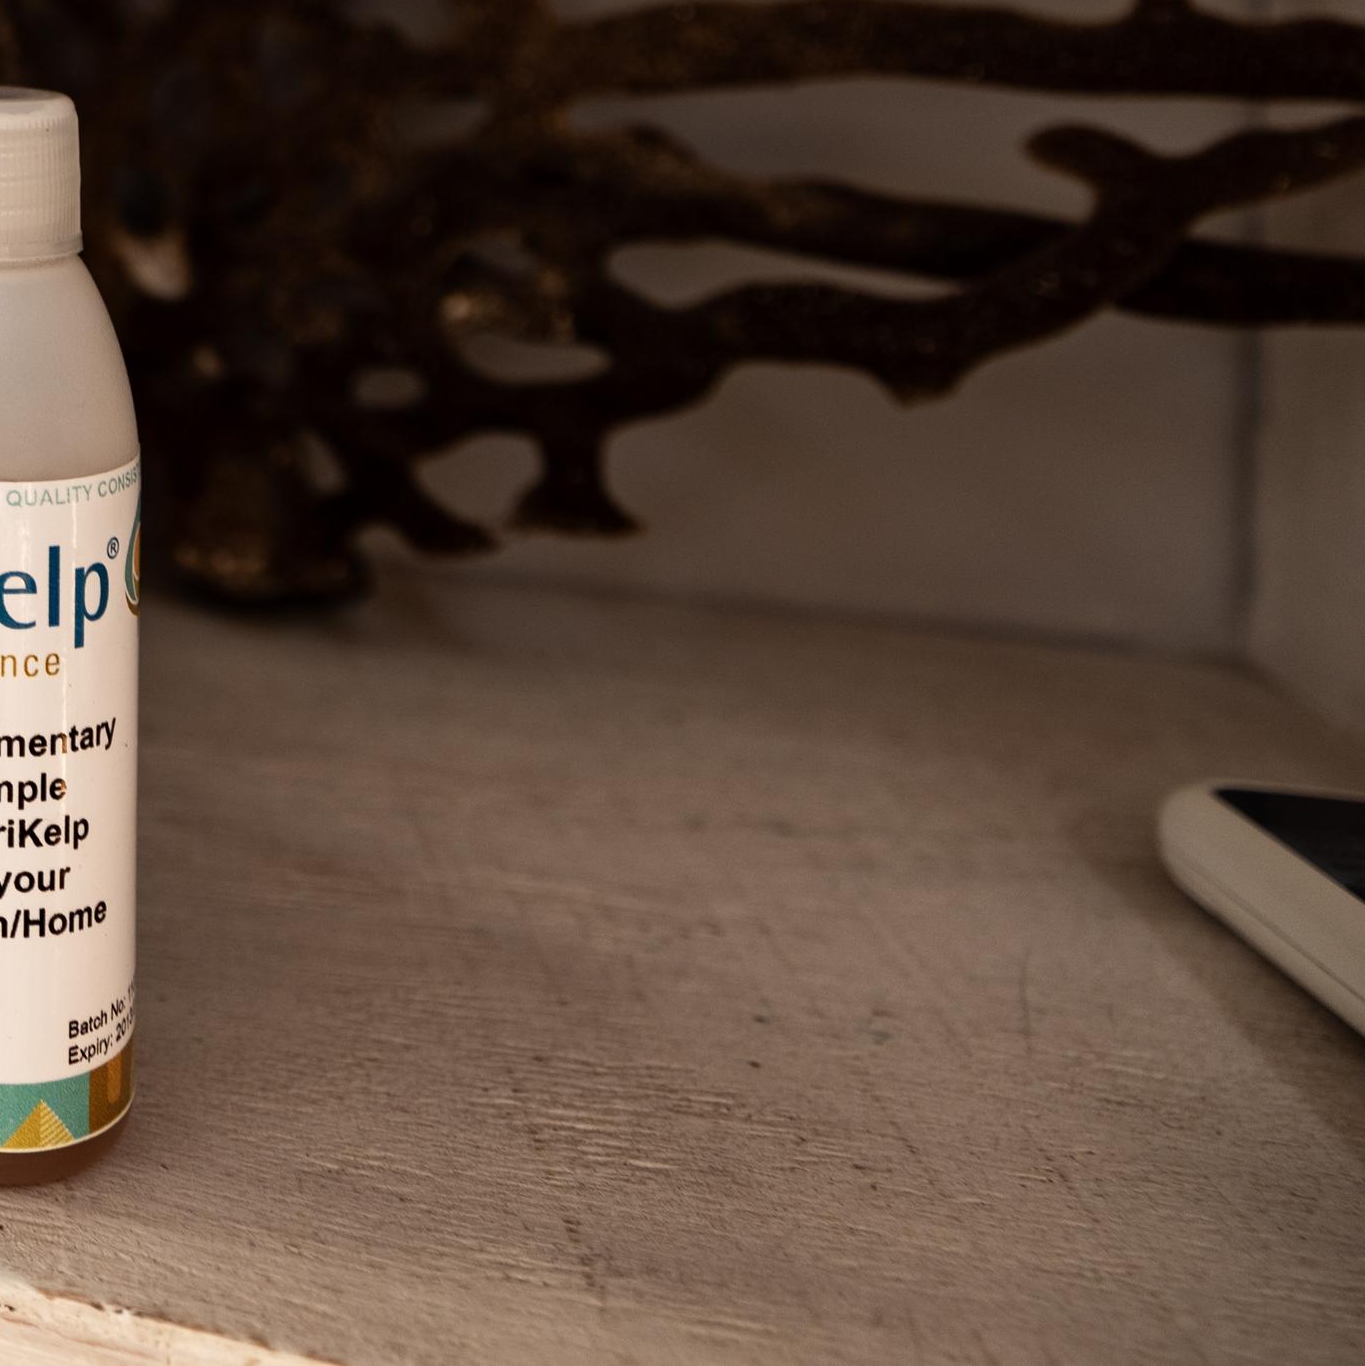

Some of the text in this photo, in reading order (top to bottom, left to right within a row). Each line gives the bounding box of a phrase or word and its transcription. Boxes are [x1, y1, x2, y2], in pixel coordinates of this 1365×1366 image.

[5, 484, 94, 508] QUALITY
[68, 1008, 108, 1040] Batch
[68, 1033, 113, 1065] Expiry:
